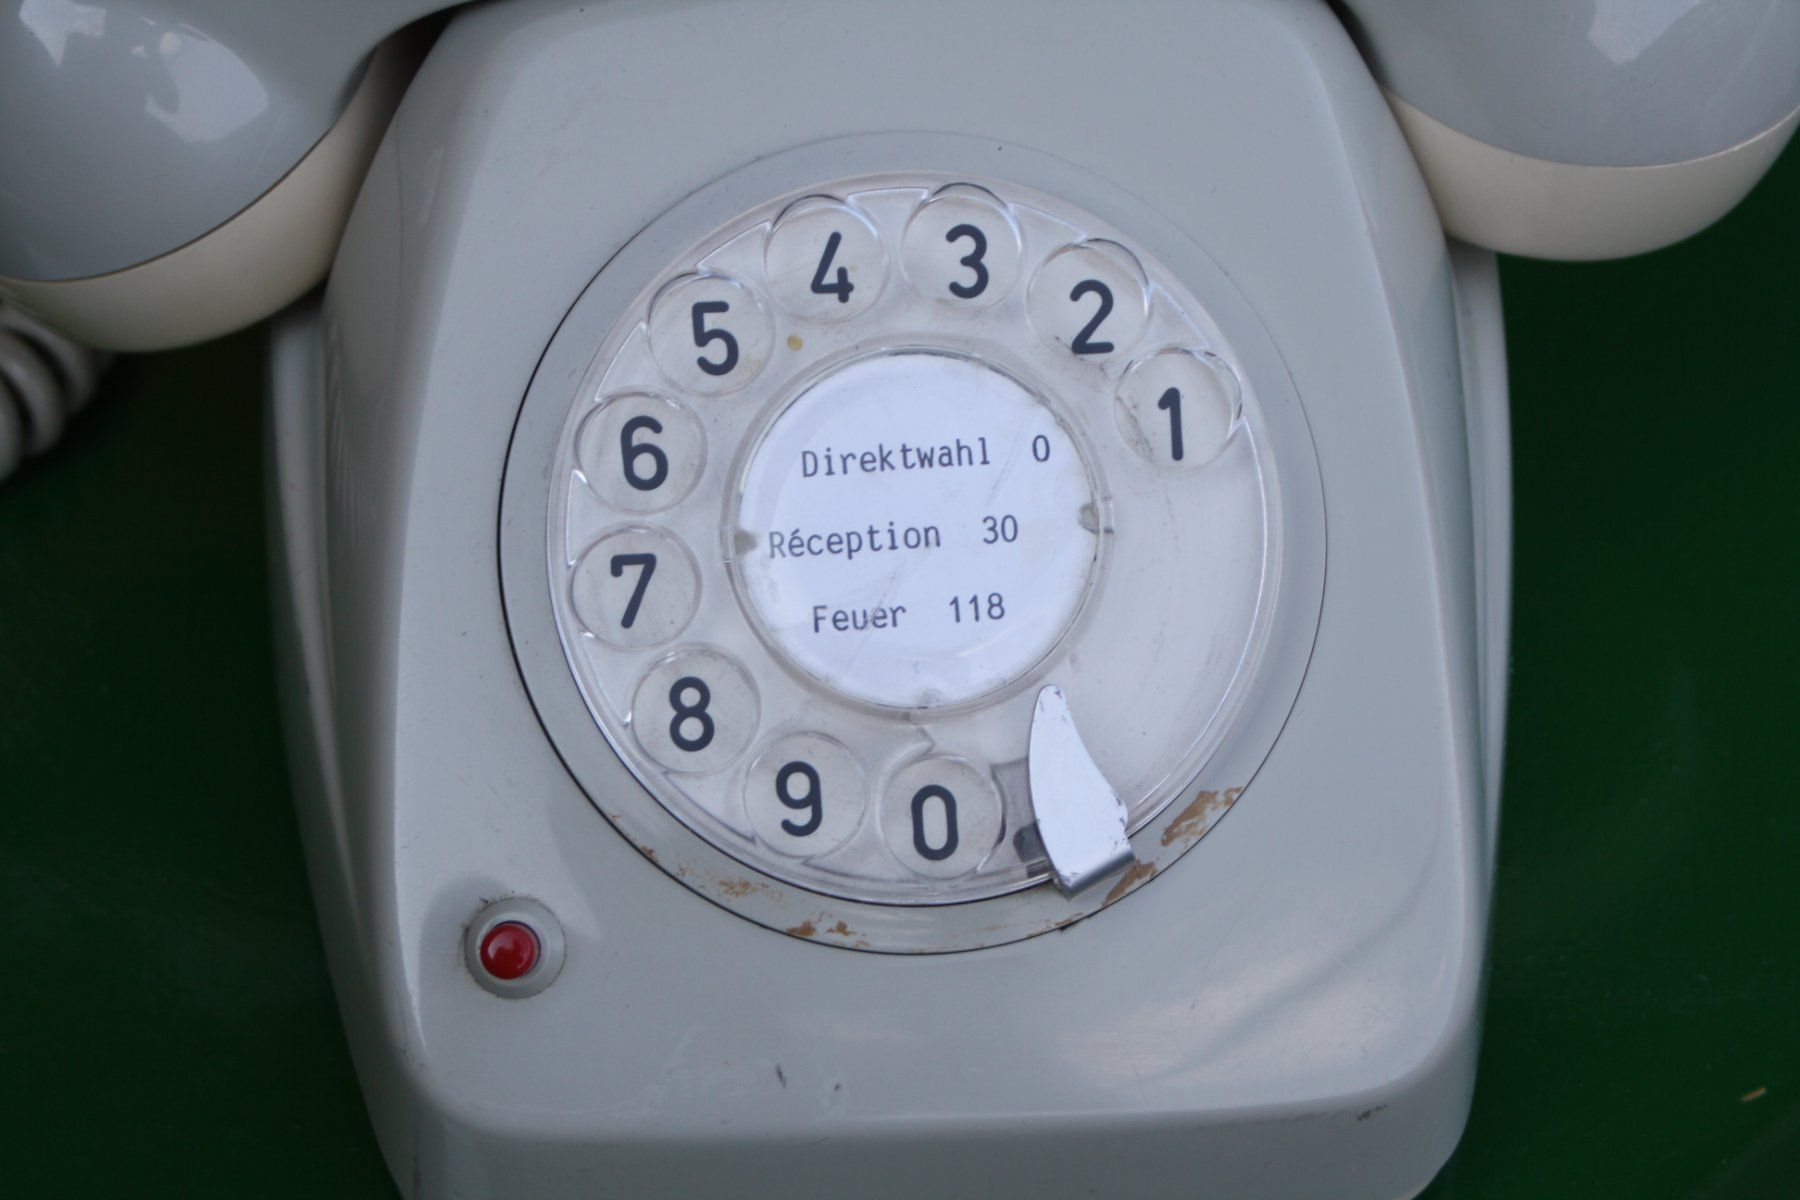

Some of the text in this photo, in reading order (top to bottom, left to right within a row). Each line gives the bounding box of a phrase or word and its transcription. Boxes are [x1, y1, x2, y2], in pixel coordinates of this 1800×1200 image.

[810, 231, 854, 303] 4
[946, 223, 989, 299] 3
[692, 301, 739, 376] 5
[1069, 279, 1114, 355] 2
[621, 415, 668, 491] 6
[801, 434, 1050, 478] Direktwahl 0
[1157, 387, 1184, 461] 1
[768, 515, 1019, 560] Réception 30
[610, 553, 657, 629] 7
[812, 592, 1006, 634] Feuer 118
[669, 676, 715, 752] 8
[775, 761, 822, 837] 9
[911, 785, 958, 861] 0
